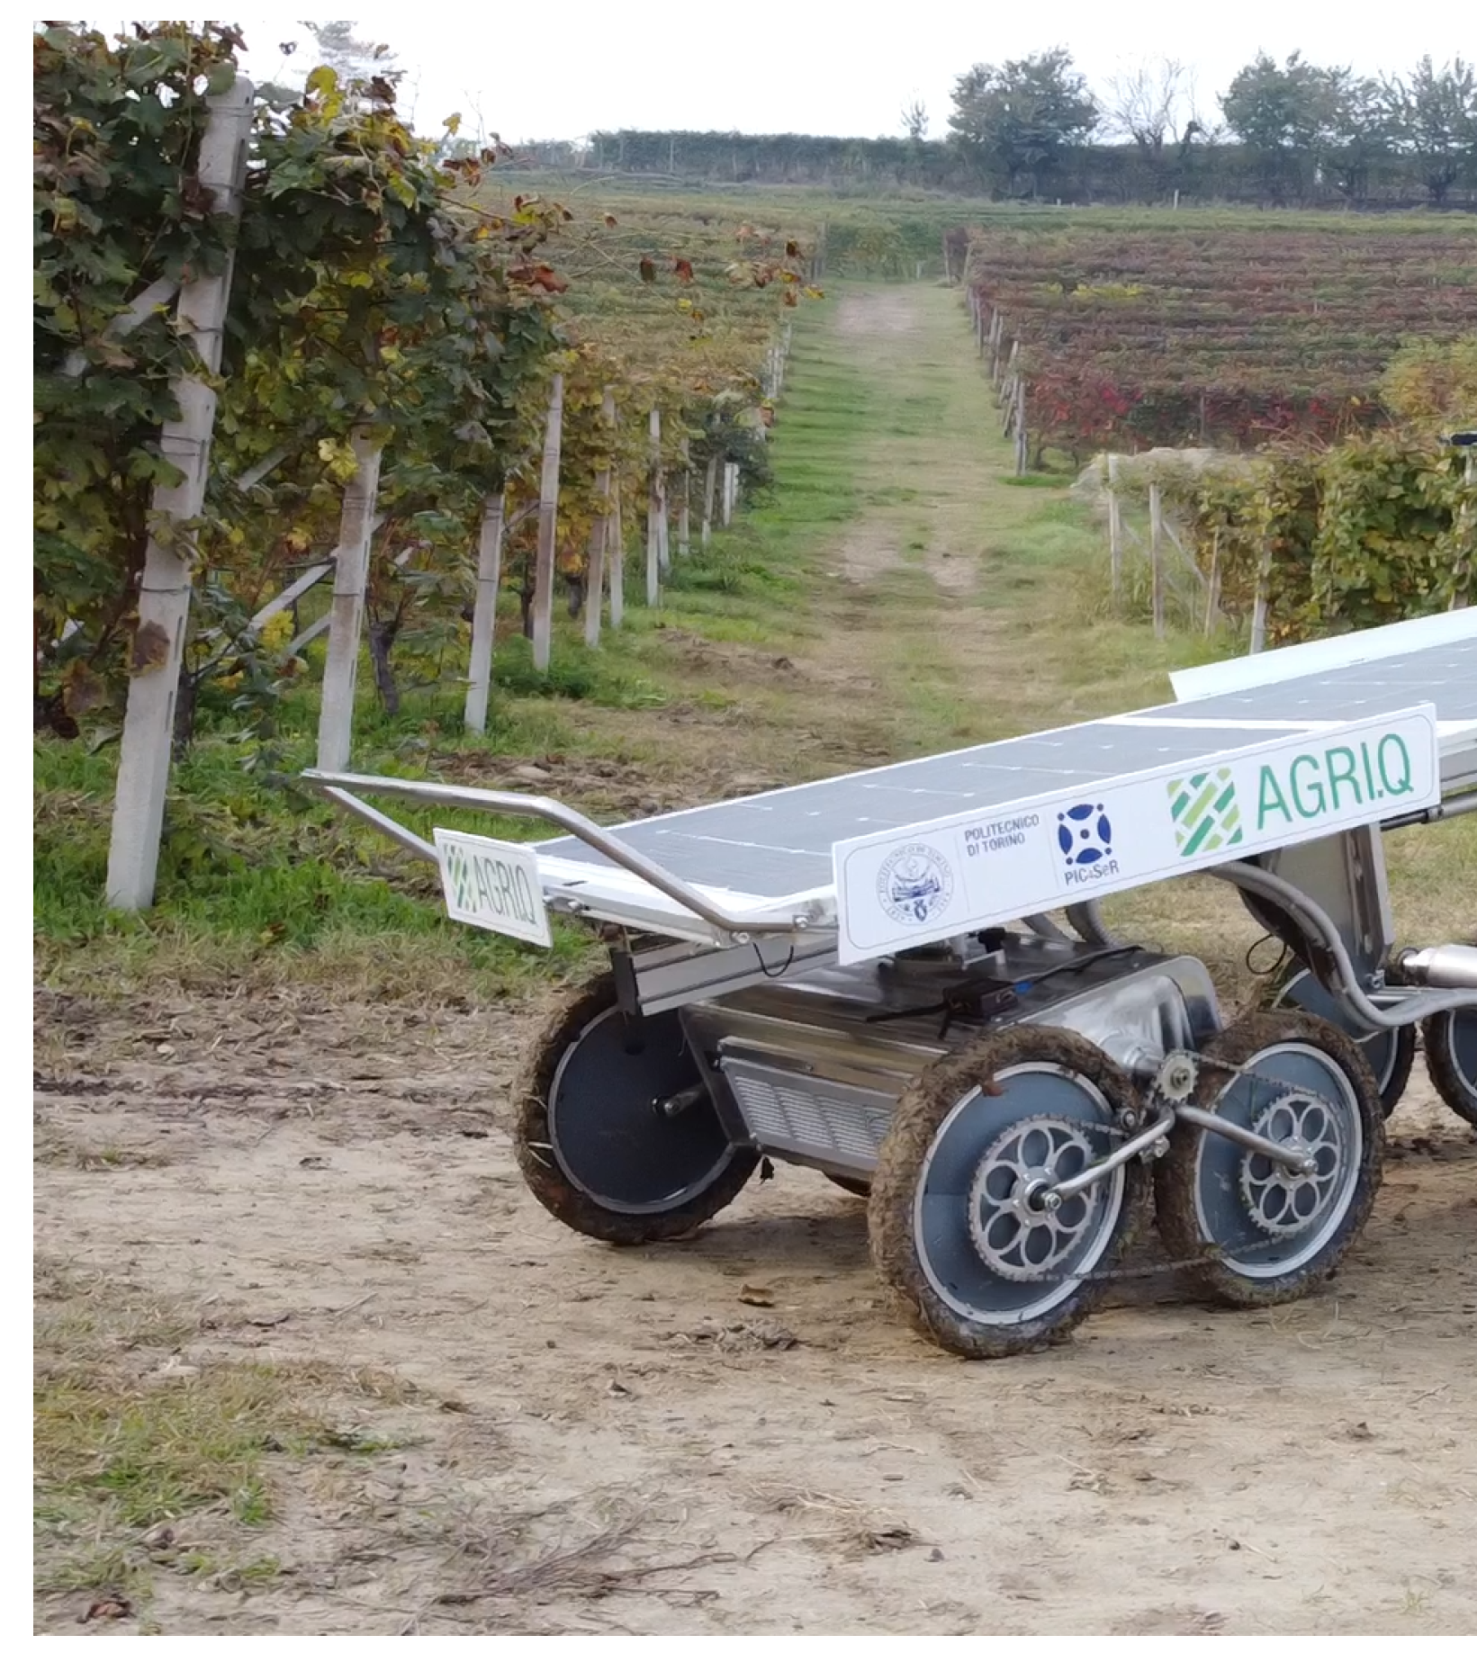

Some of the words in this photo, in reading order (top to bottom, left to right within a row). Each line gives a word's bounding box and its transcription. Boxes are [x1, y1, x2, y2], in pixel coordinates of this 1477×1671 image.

[1257, 733, 1414, 830] AGRI.Q
[964, 814, 1040, 842] POLITECNICO
[967, 843, 980, 857] DI
[982, 832, 1026, 853] TORINO
